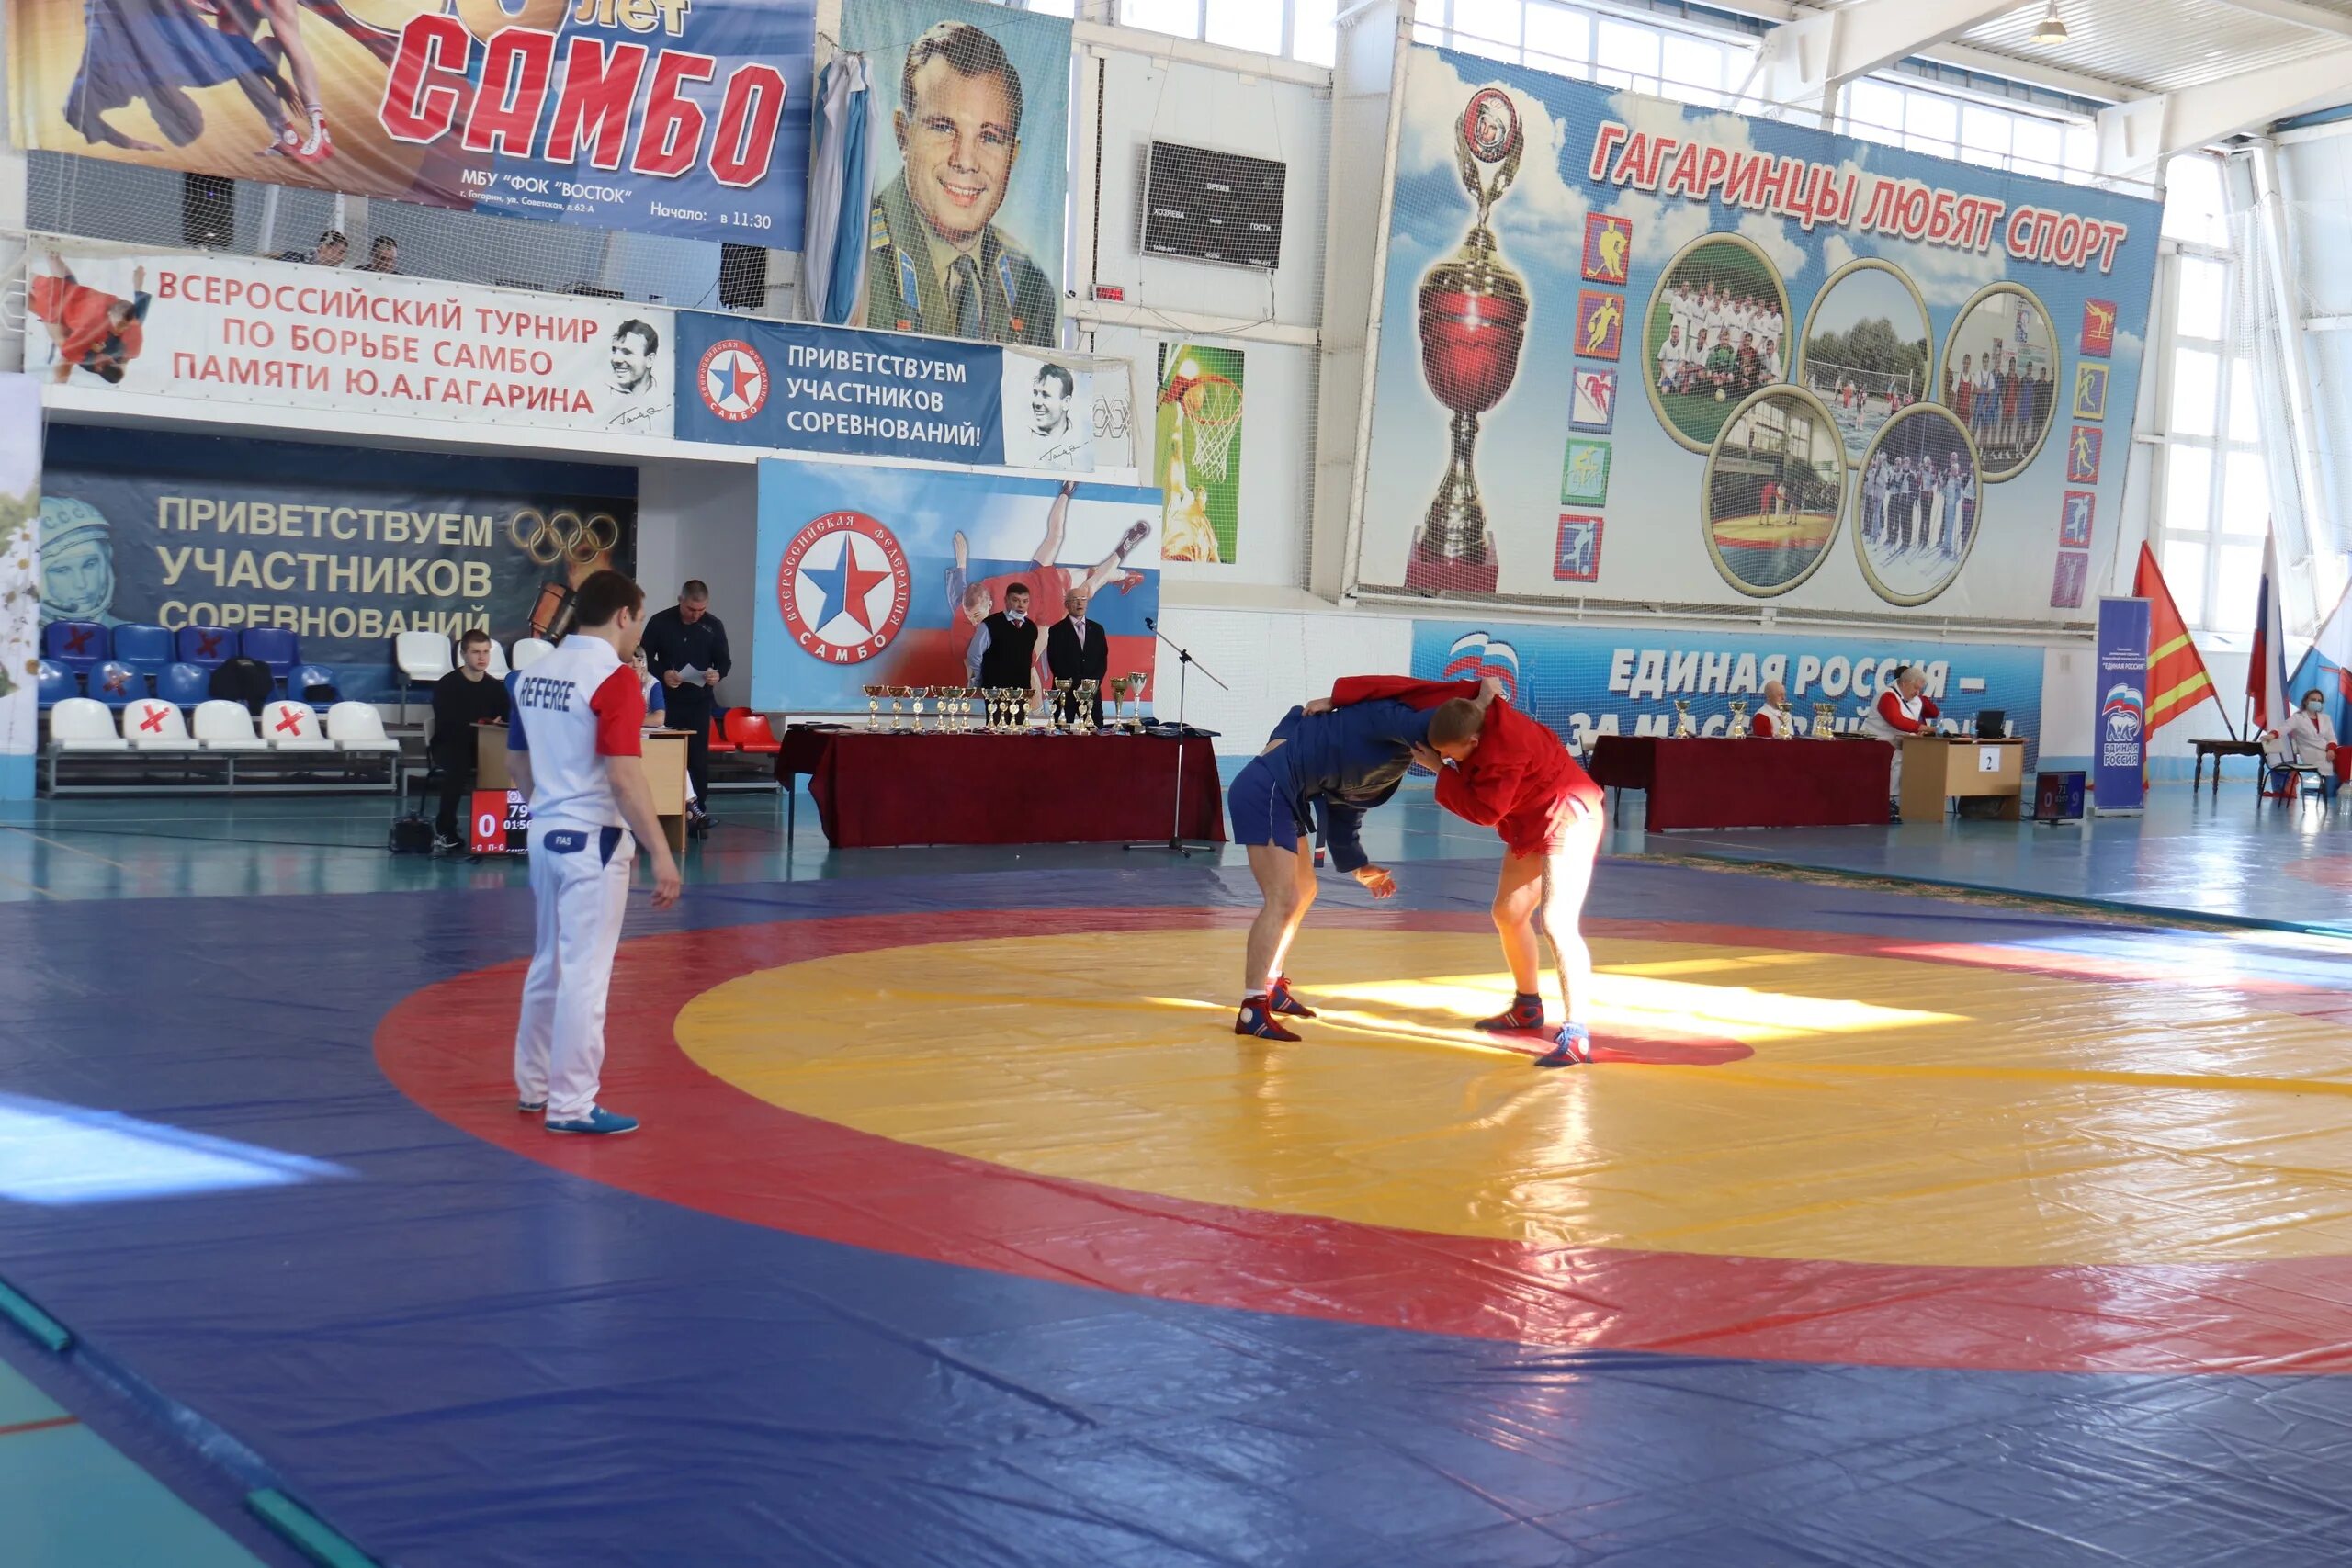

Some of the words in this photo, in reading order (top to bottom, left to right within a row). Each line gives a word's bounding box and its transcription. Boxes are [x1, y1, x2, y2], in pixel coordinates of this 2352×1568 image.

[378, 12, 787, 188] САМБО
[461, 169, 498, 186] МБУ
[1206, 183, 1230, 193] ВРЕМЯ
[1589, 122, 1857, 230] ГАГАРИНЦЫ
[1861, 179, 2004, 248] ЛЮБЯТ
[2007, 207, 2127, 272] СПОРТ
[650, 201, 707, 222] Начало:
[720, 213, 728, 224] в
[732, 211, 772, 230] 11:30
[1153, 208, 1184, 219] ХОЗЯЕВА
[1250, 222, 1271, 232] ГОСТИ
[158, 272, 461, 331] ВСЕРОССИЙСКИЙ
[475, 308, 598, 343] ТУРНИР
[223, 318, 275, 348] ПО
[291, 324, 419, 364] БОРЬБЕ
[434, 341, 553, 376] САМБО
[788, 345, 967, 383] ПРИВЕТСТВУЕМ
[173, 352, 329, 392] ПАМЯТИ
[345, 367, 594, 413] Ю.А.ГАГАРИНА
[786, 378, 944, 412] УЧАСТНИКОВ
[710, 402, 758, 421] САМБО
[786, 411, 981, 447] СОРЕВНОВАНИЙ!
[158, 496, 493, 547] ПРИВЕТСТВУЕМ
[156, 546, 492, 598] УЧАСТНИКОВ
[782, 515, 854, 623] ВСЕРОССИЙСКАЯ
[799, 632, 886, 661] САМБО
[1608, 649, 1786, 699] ЕДИНАЯ
[519, 676, 576, 713] REFEREE
[1985, 756, 1992, 770] 2
[2104, 742, 2139, 755] ЕДИНАЯ
[2104, 754, 2138, 766] РОССИЯ
[509, 805, 528, 818] 79
[2044, 792, 2052, 807] 0
[2072, 791, 2080, 807] 9
[478, 814, 496, 838] 0
[555, 836, 571, 845] FIAS
